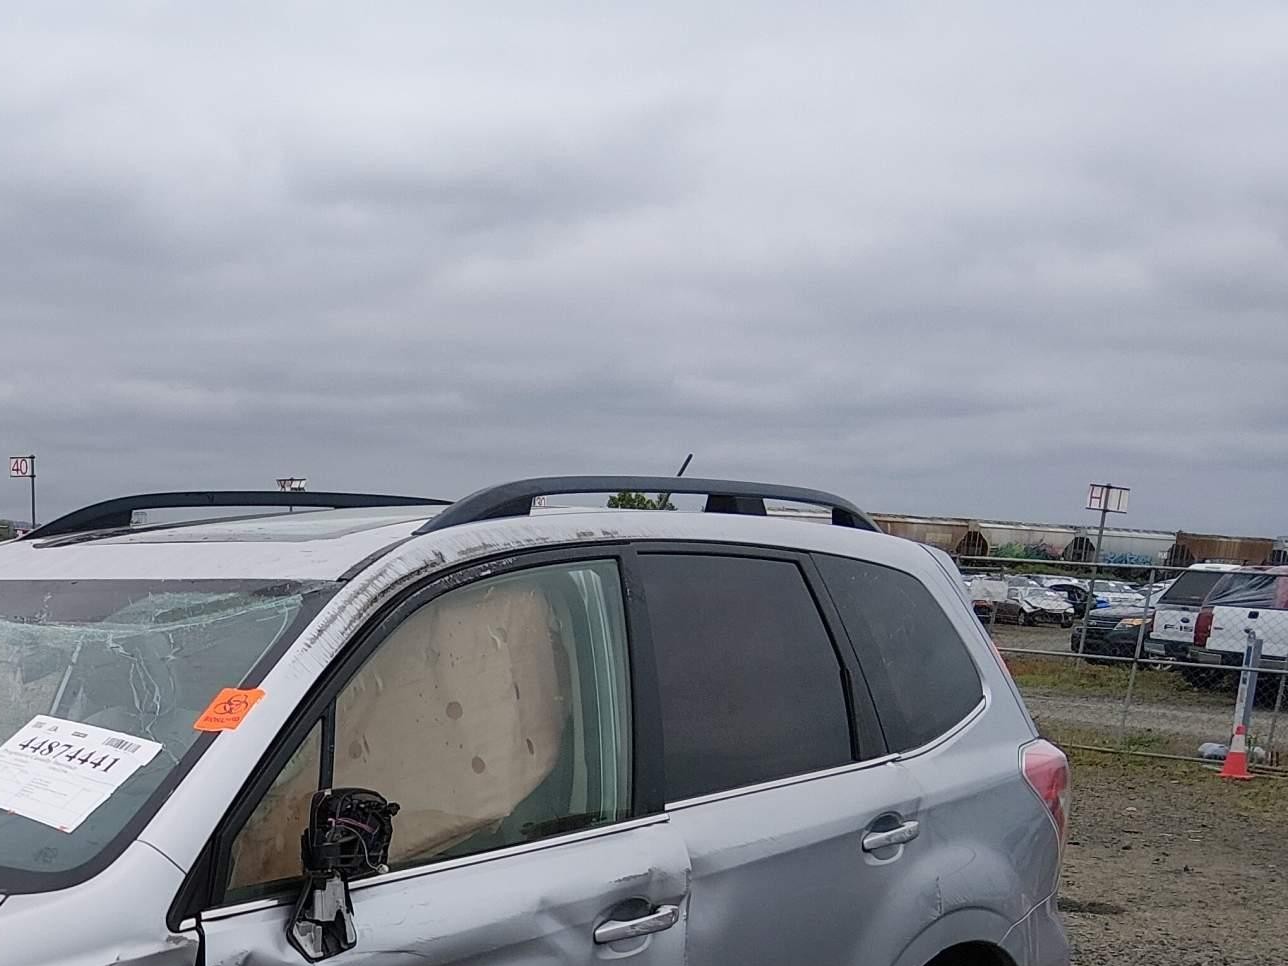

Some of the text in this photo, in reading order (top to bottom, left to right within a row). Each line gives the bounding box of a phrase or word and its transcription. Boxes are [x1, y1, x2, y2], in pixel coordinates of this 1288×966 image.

[11, 458, 28, 475] 40
[1089, 486, 1104, 508] H
[1163, 623, 1193, 633] F-15
[18, 736, 120, 773] 44874441
